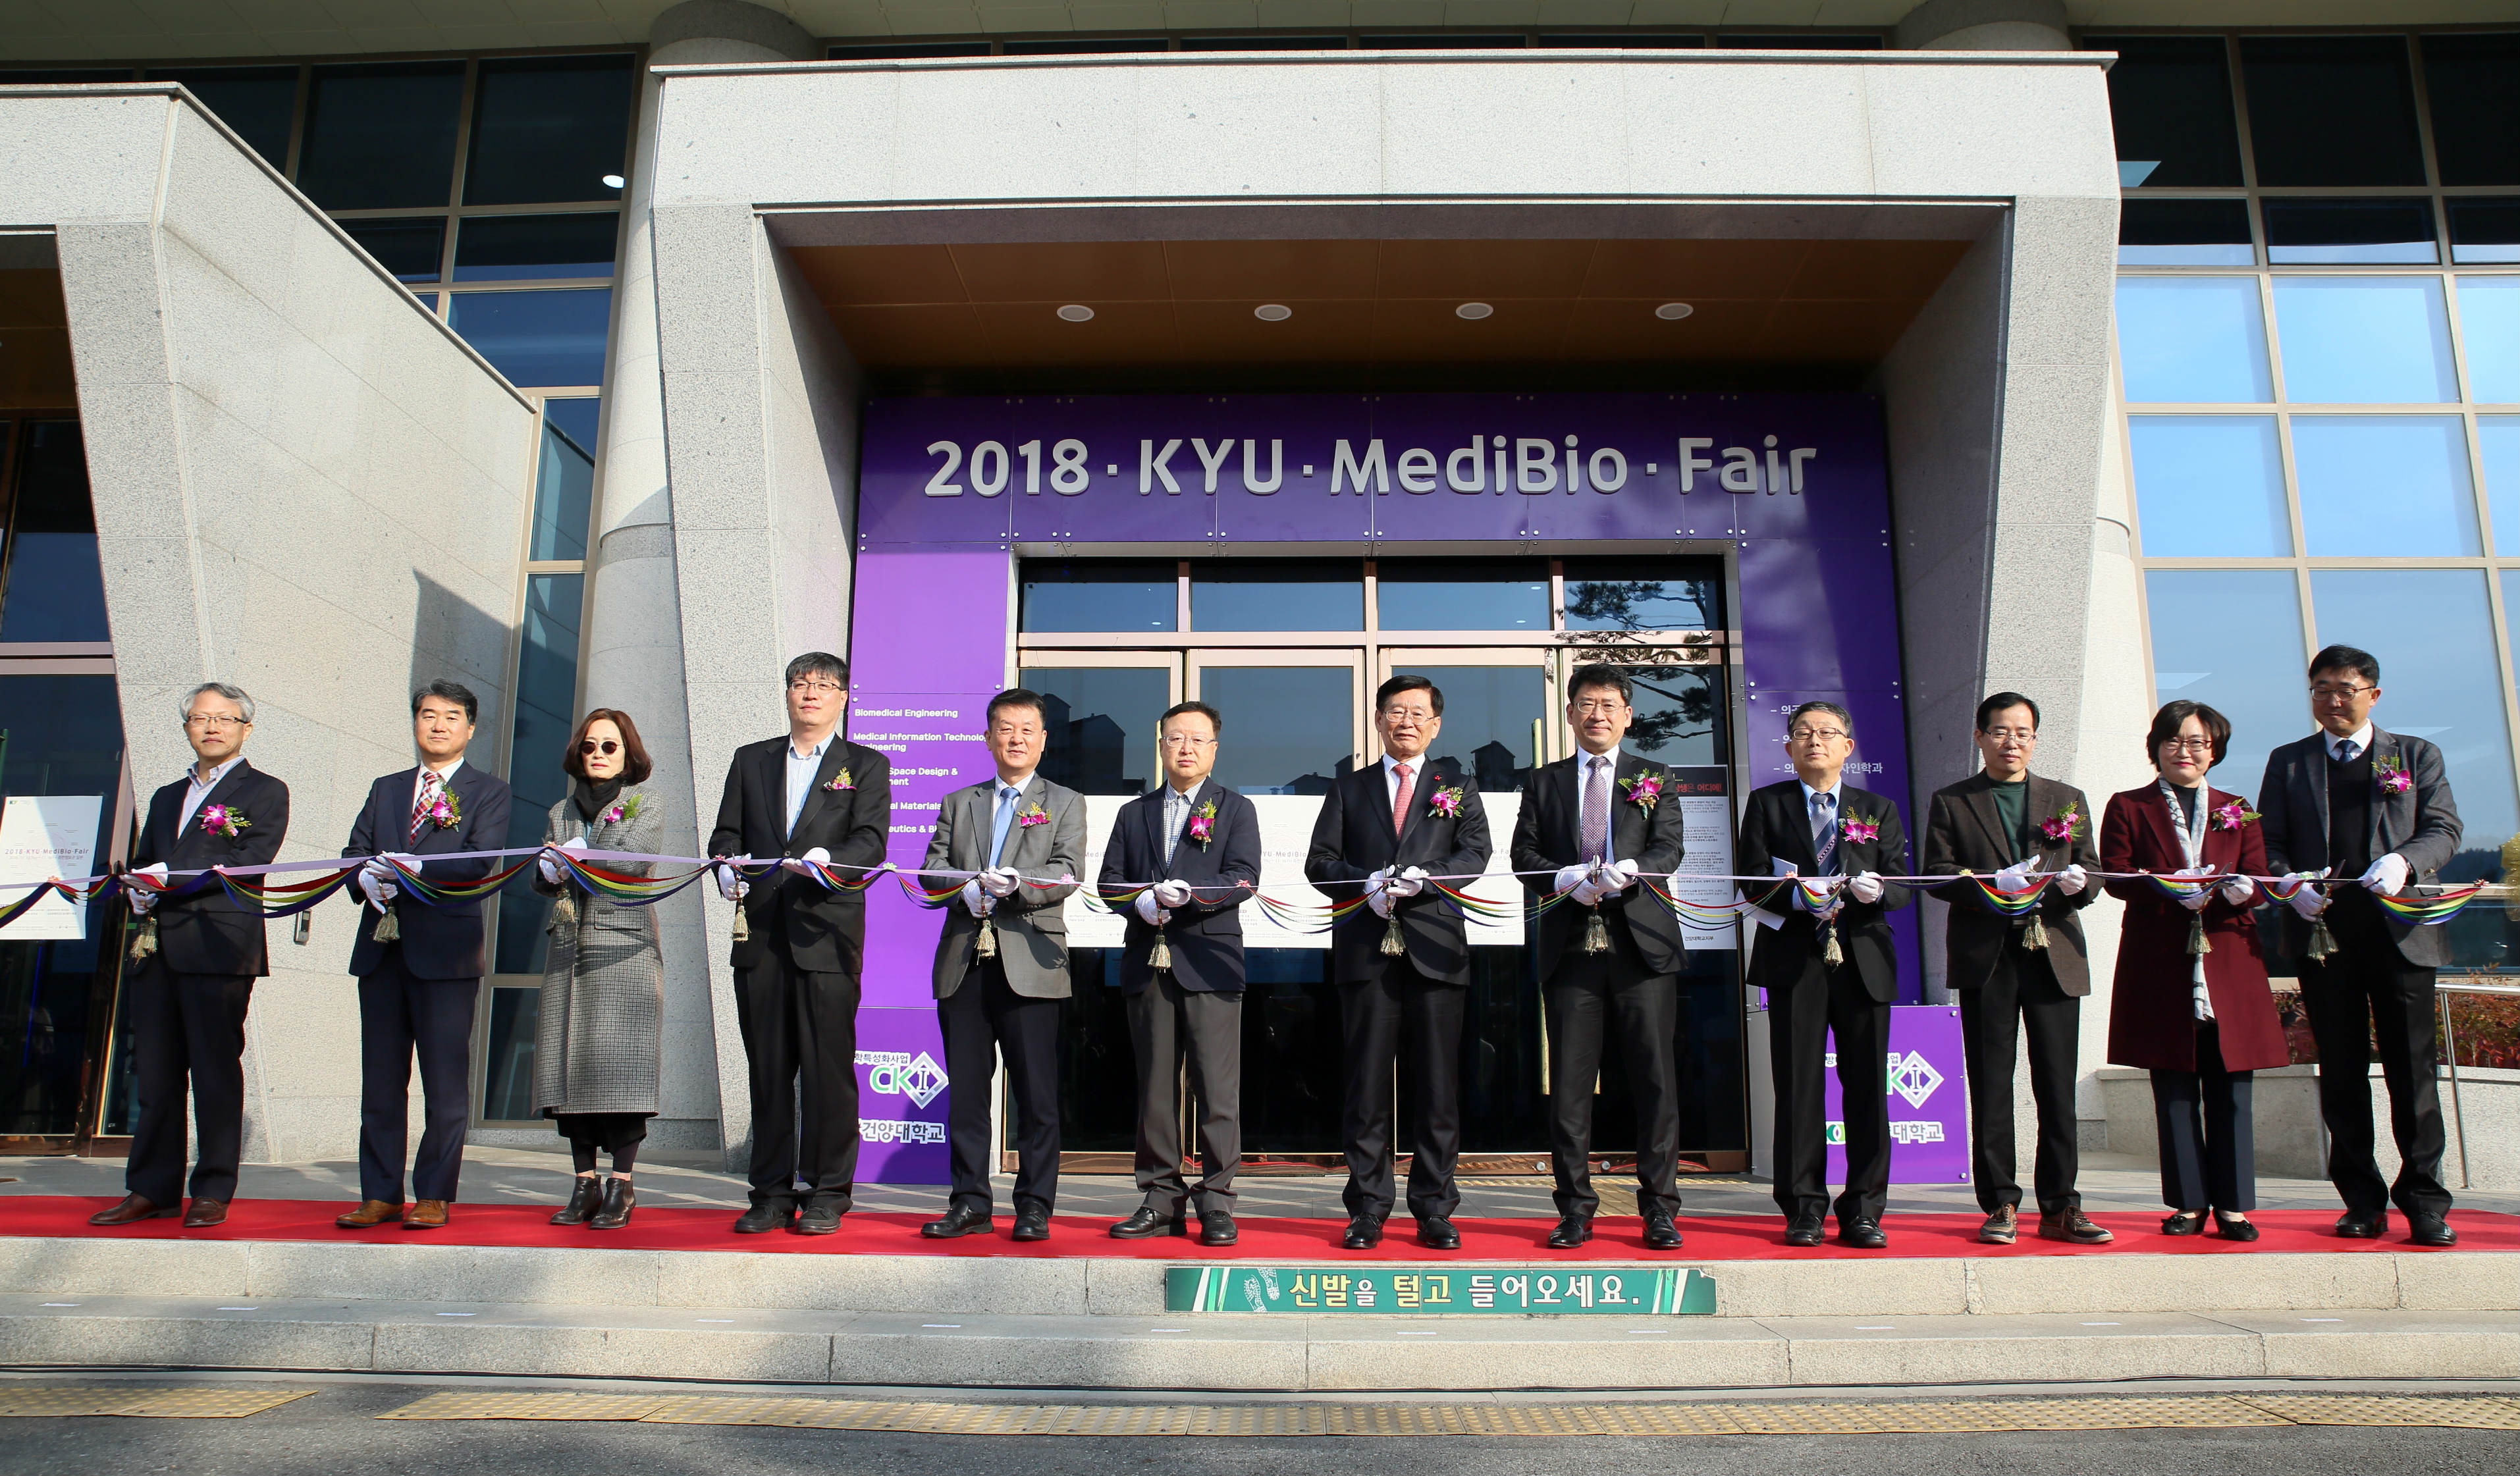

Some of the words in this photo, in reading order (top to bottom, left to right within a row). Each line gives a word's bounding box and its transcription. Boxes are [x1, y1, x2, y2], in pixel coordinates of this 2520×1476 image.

[925, 438, 1090, 496] 2018
[1139, 438, 1283, 495] KYU
[1329, 435, 1628, 496] MediBio
[1678, 434, 1817, 495] Fair
[854, 708, 902, 717] Biomedical
[904, 708, 958, 718] Engineering
[853, 732, 888, 741] Medical
[888, 732, 942, 741] Information
[889, 767, 917, 777] Space
[918, 767, 949, 777] Design
[951, 767, 958, 776] &
[899, 801, 942, 810] Materials
[919, 825, 926, 833] &
[862, 1121, 944, 1141] 건양대학교
[1893, 1123, 1943, 1140] 대학교
[1288, 1273, 1378, 1309] 신발을
[1392, 1274, 1453, 1309] 털고
[1466, 1274, 1640, 1309] 들어오세요.
